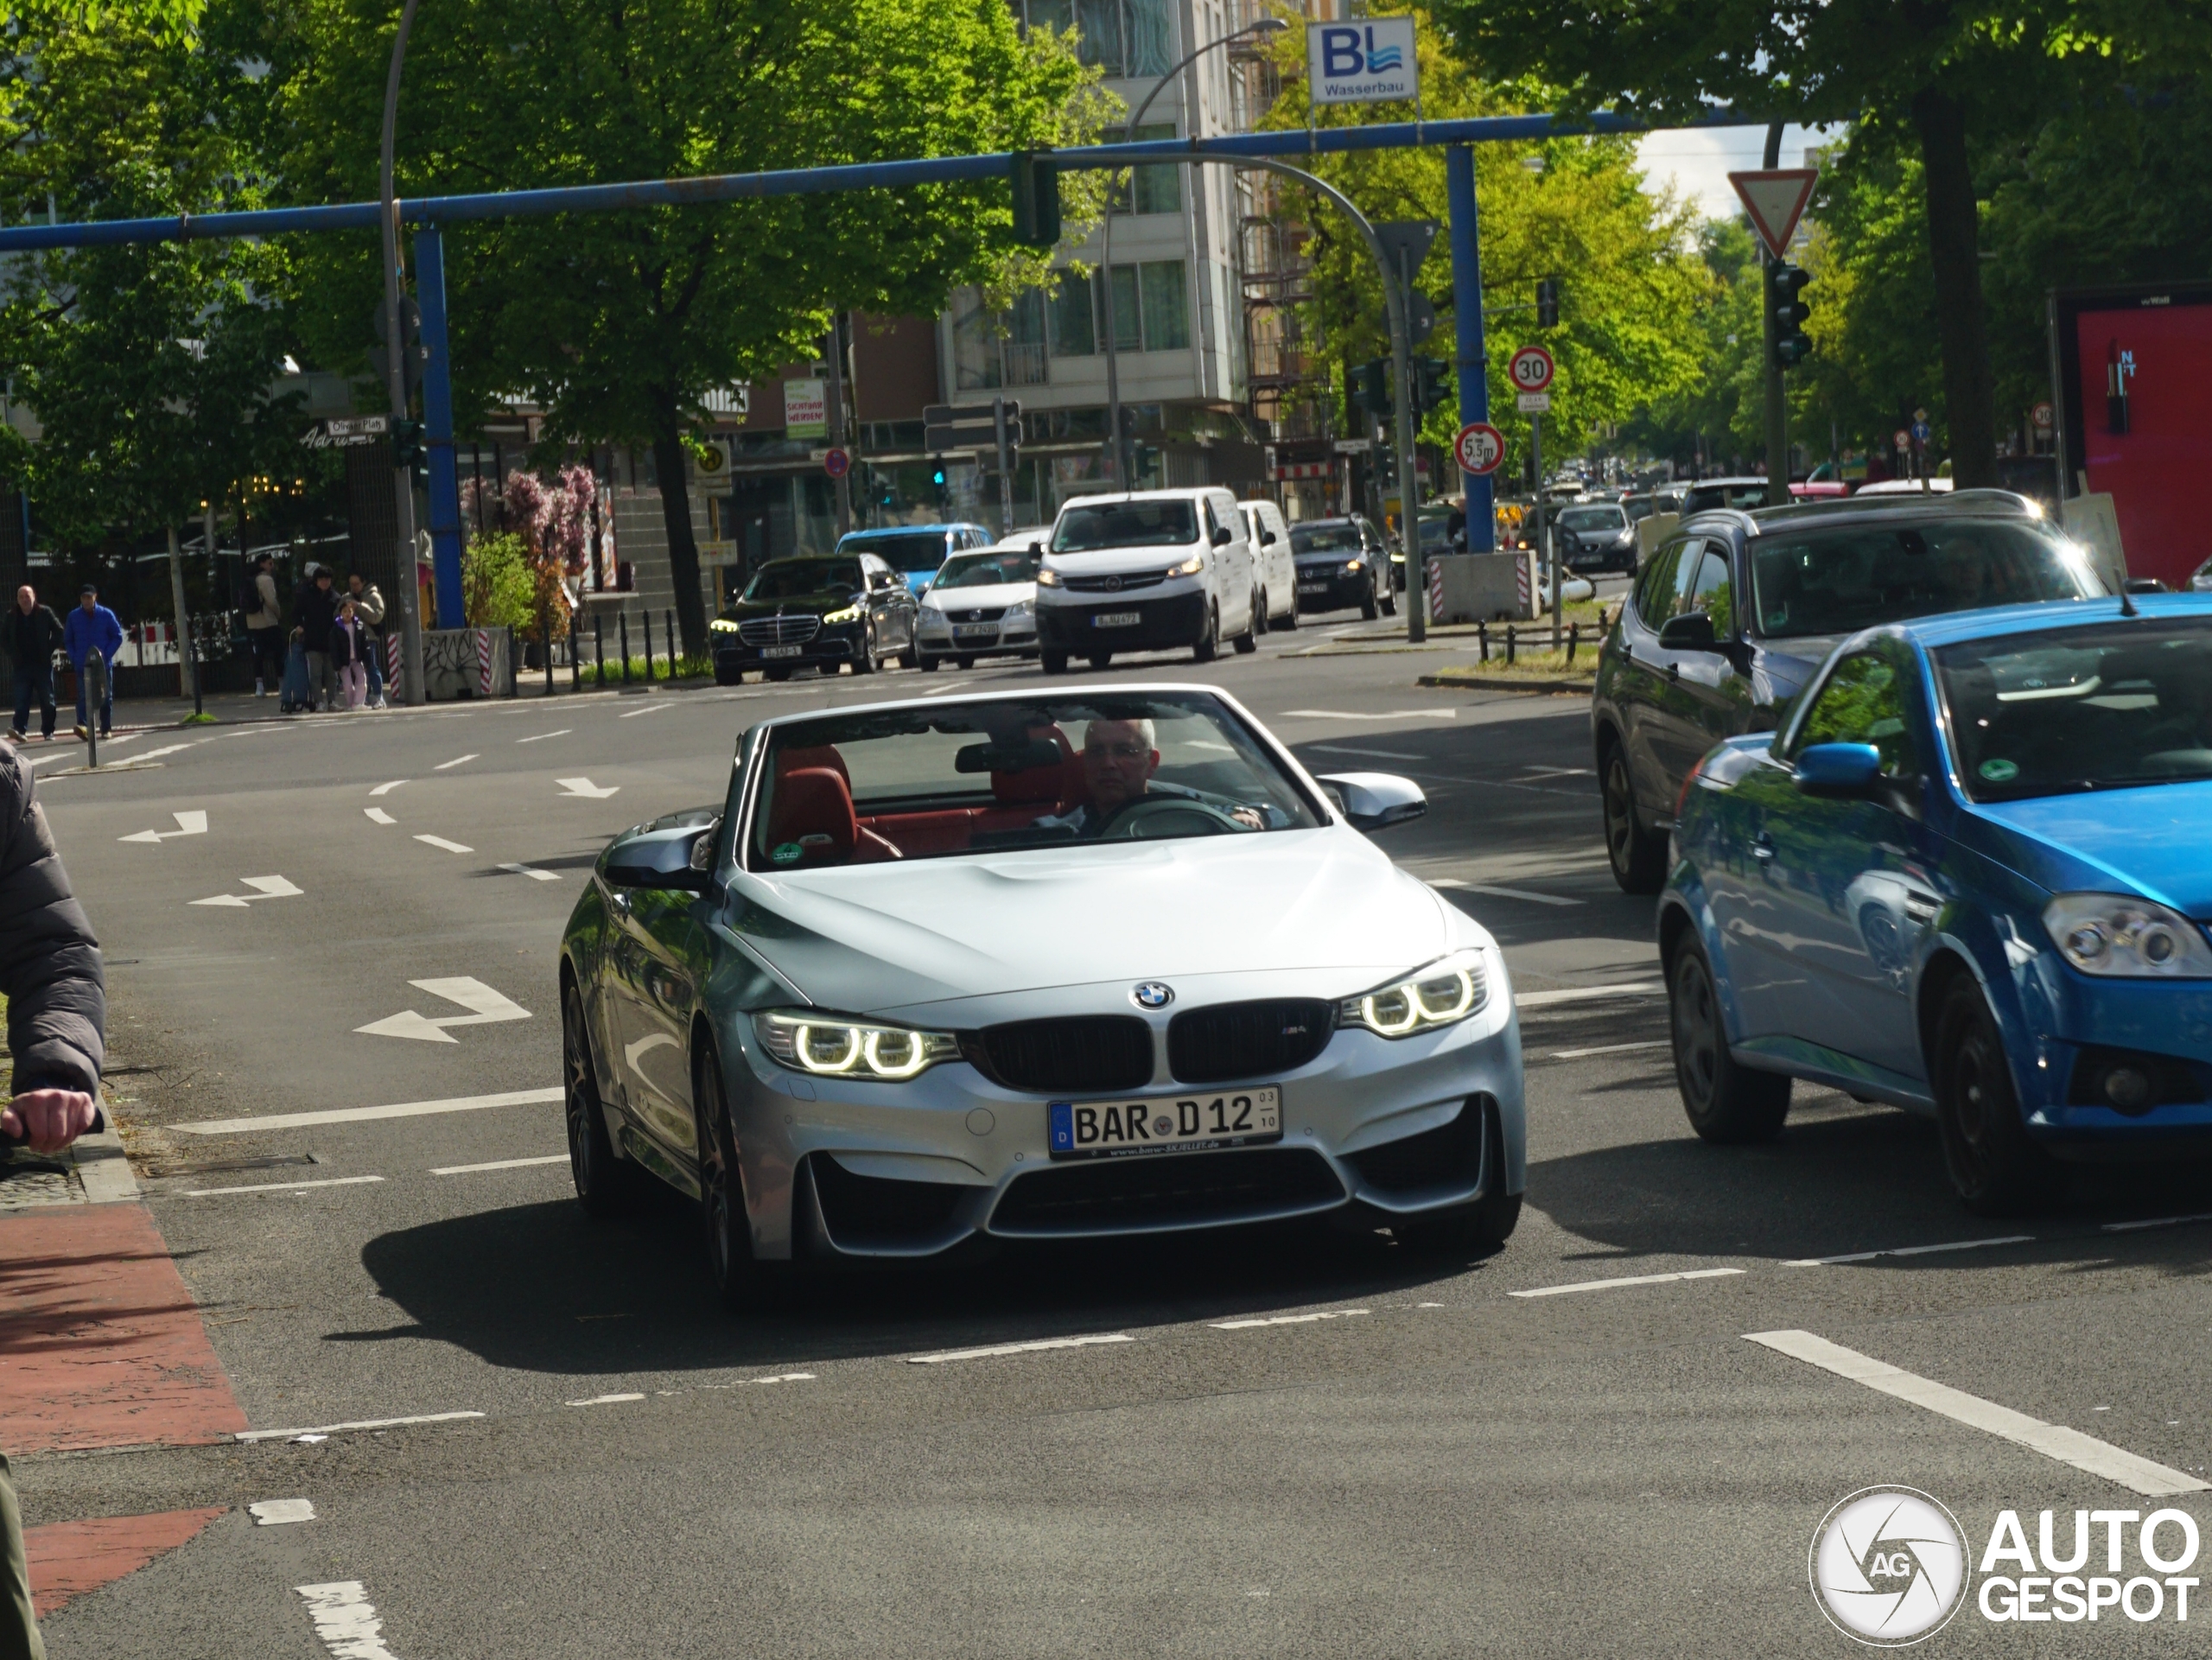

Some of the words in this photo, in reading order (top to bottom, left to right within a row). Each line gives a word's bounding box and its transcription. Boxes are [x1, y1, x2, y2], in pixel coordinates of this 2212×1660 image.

[1325, 82, 1404, 96] Wasserbau
[1518, 359, 1544, 380] 30
[1259, 1091, 1274, 1103] 03
[1075, 1103, 1150, 1143] BAR
[1176, 1100, 1200, 1136] D
[1208, 1096, 1253, 1134] 12
[1261, 1116, 1275, 1128] 10
[1058, 1132, 1067, 1142] D
